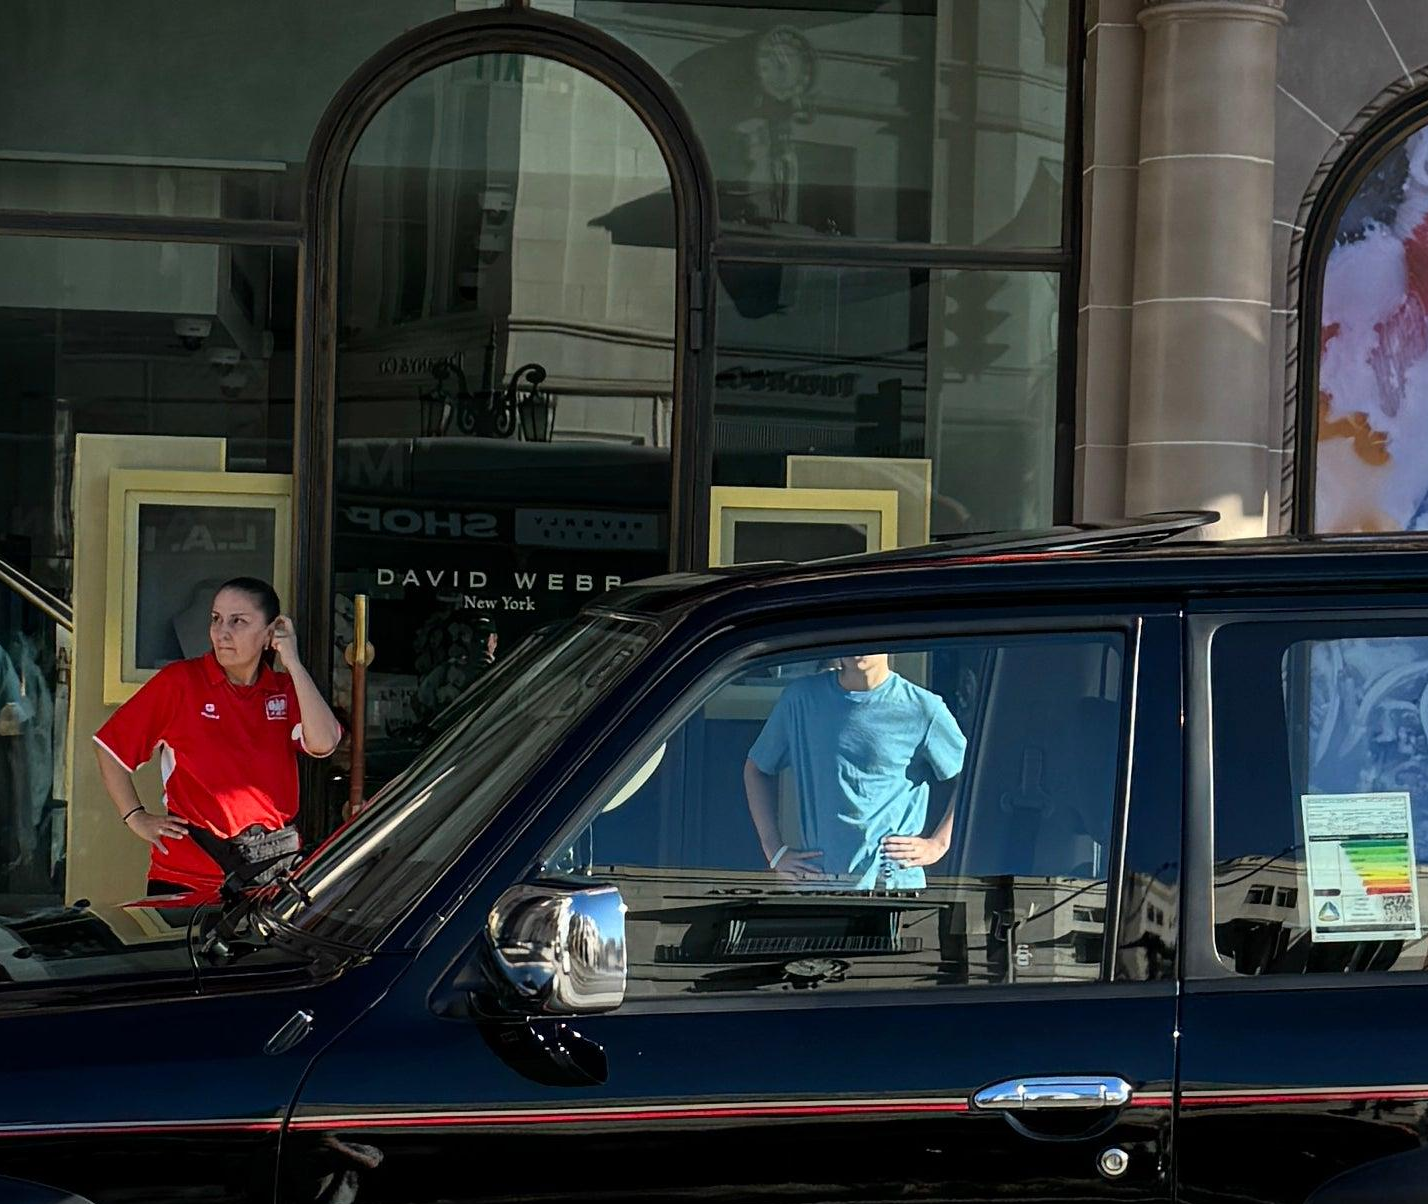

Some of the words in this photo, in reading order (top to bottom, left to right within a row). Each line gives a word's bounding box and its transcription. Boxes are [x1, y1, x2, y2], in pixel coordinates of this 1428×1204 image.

[377, 568, 488, 588] DAVID
[514, 573, 622, 592] WEBB
[463, 595, 498, 610] New
[502, 596, 536, 611] York
